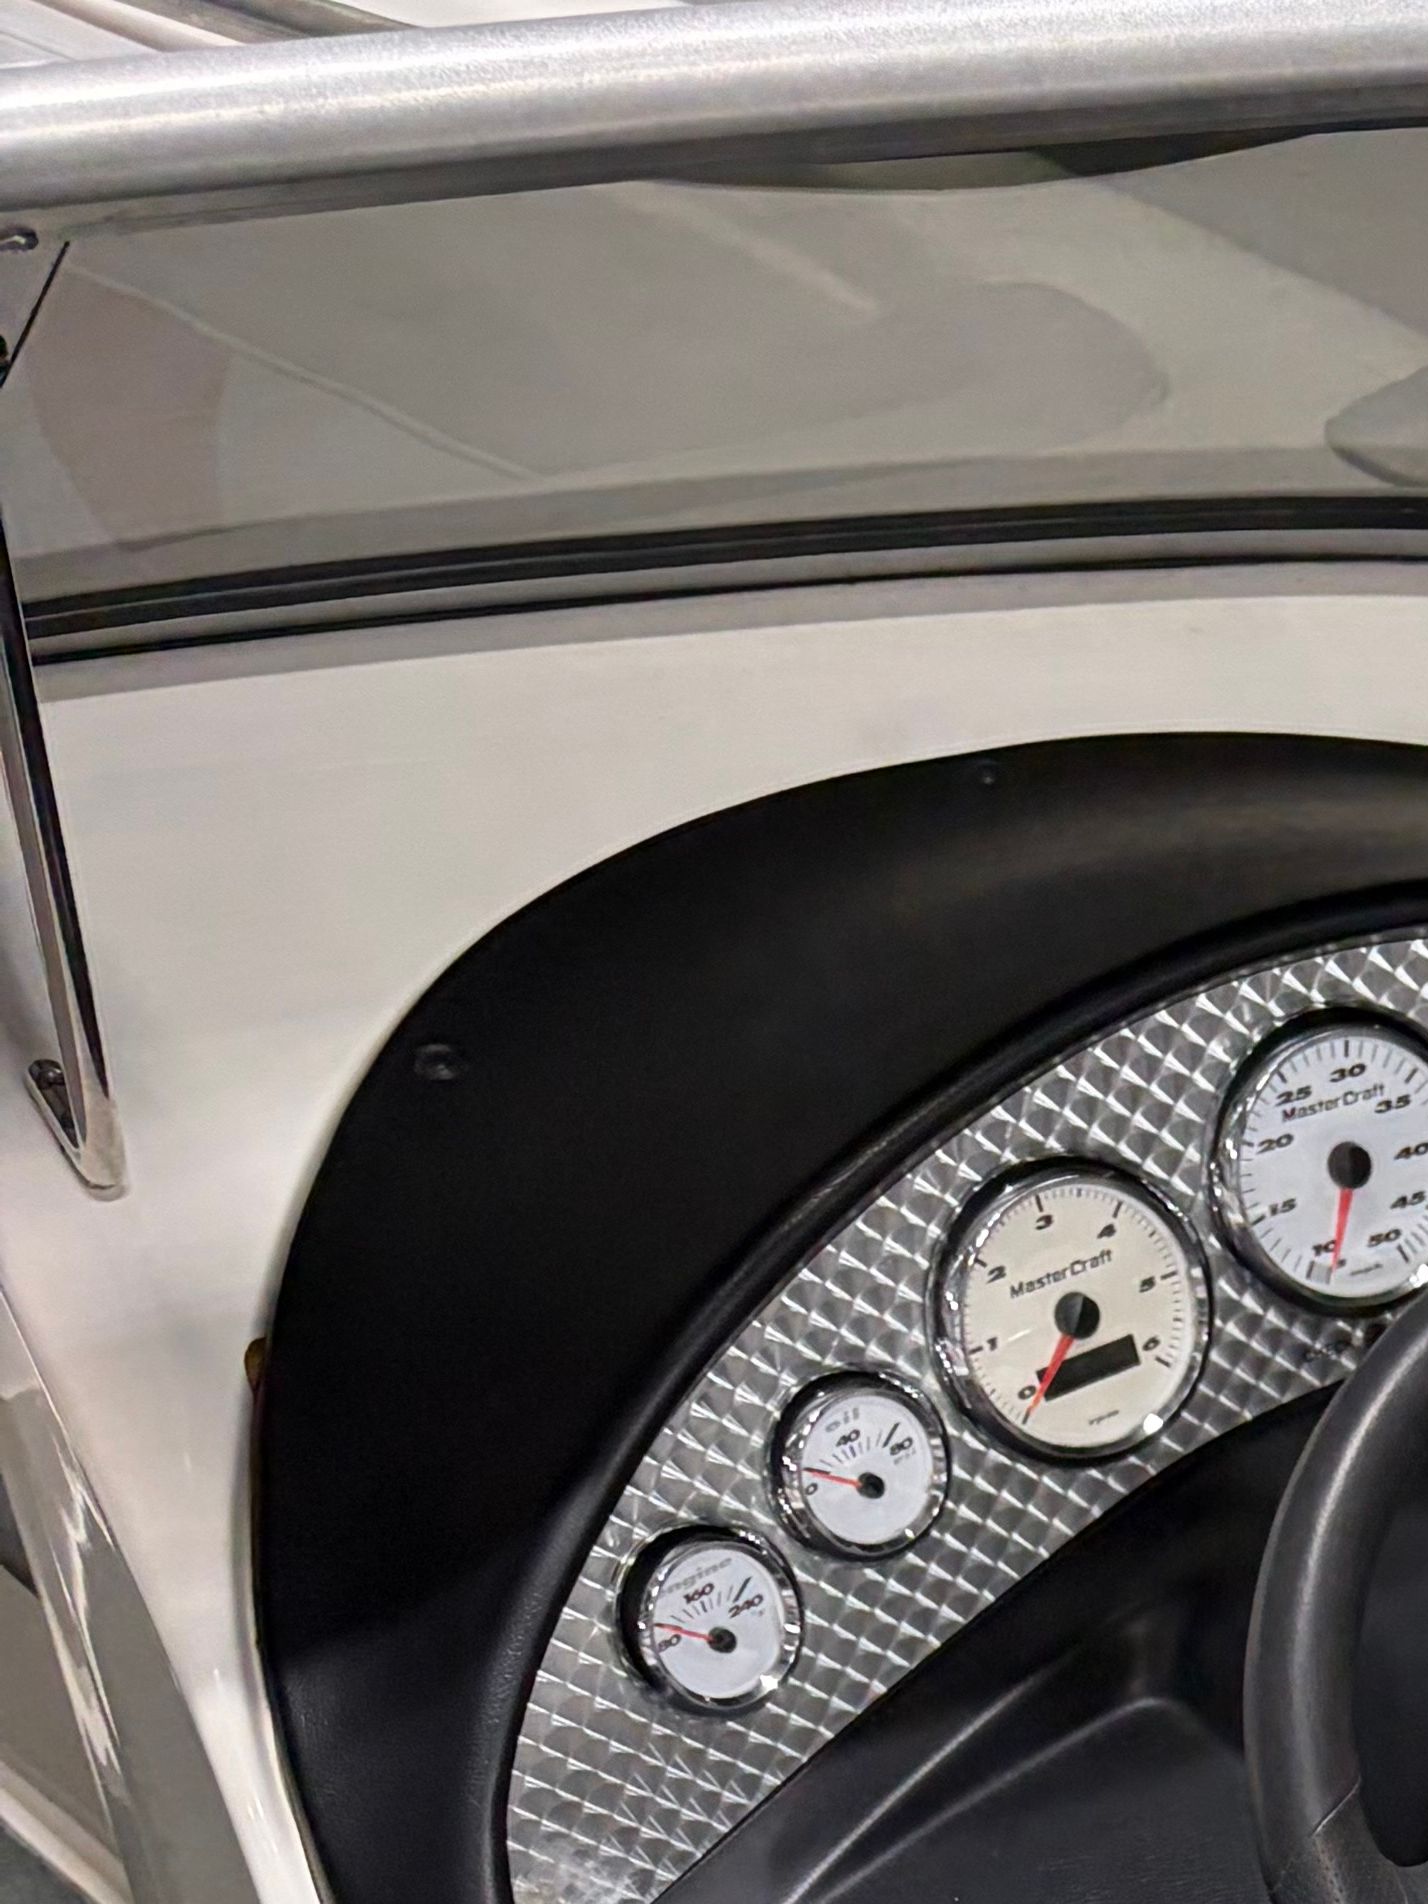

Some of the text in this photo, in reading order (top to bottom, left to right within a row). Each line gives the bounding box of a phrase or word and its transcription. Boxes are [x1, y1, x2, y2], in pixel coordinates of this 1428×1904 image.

[1329, 1063, 1367, 1083] 30
[1274, 1085, 1312, 1107] 25
[1282, 1083, 1385, 1123] MasterCraft
[1373, 1094, 1413, 1114] 35
[1256, 1133, 1295, 1154] 20
[1268, 1198, 1297, 1217] 15
[1390, 1191, 1427, 1210] 45
[1035, 1214, 1054, 1230] 3
[1096, 1223, 1117, 1239] 4
[1367, 1228, 1402, 1248] 50
[986, 1265, 1007, 1284] 2
[1009, 1249, 1114, 1300] MasterCraft
[1138, 1276, 1156, 1293] 5
[986, 1337, 998, 1351] 1
[1142, 1337, 1160, 1351] 6
[1018, 1385, 1036, 1400] 0
[836, 1429, 861, 1448] 40
[805, 1482, 818, 1496] 0
[683, 1582, 715, 1604] 160
[728, 1594, 764, 1619] 240
